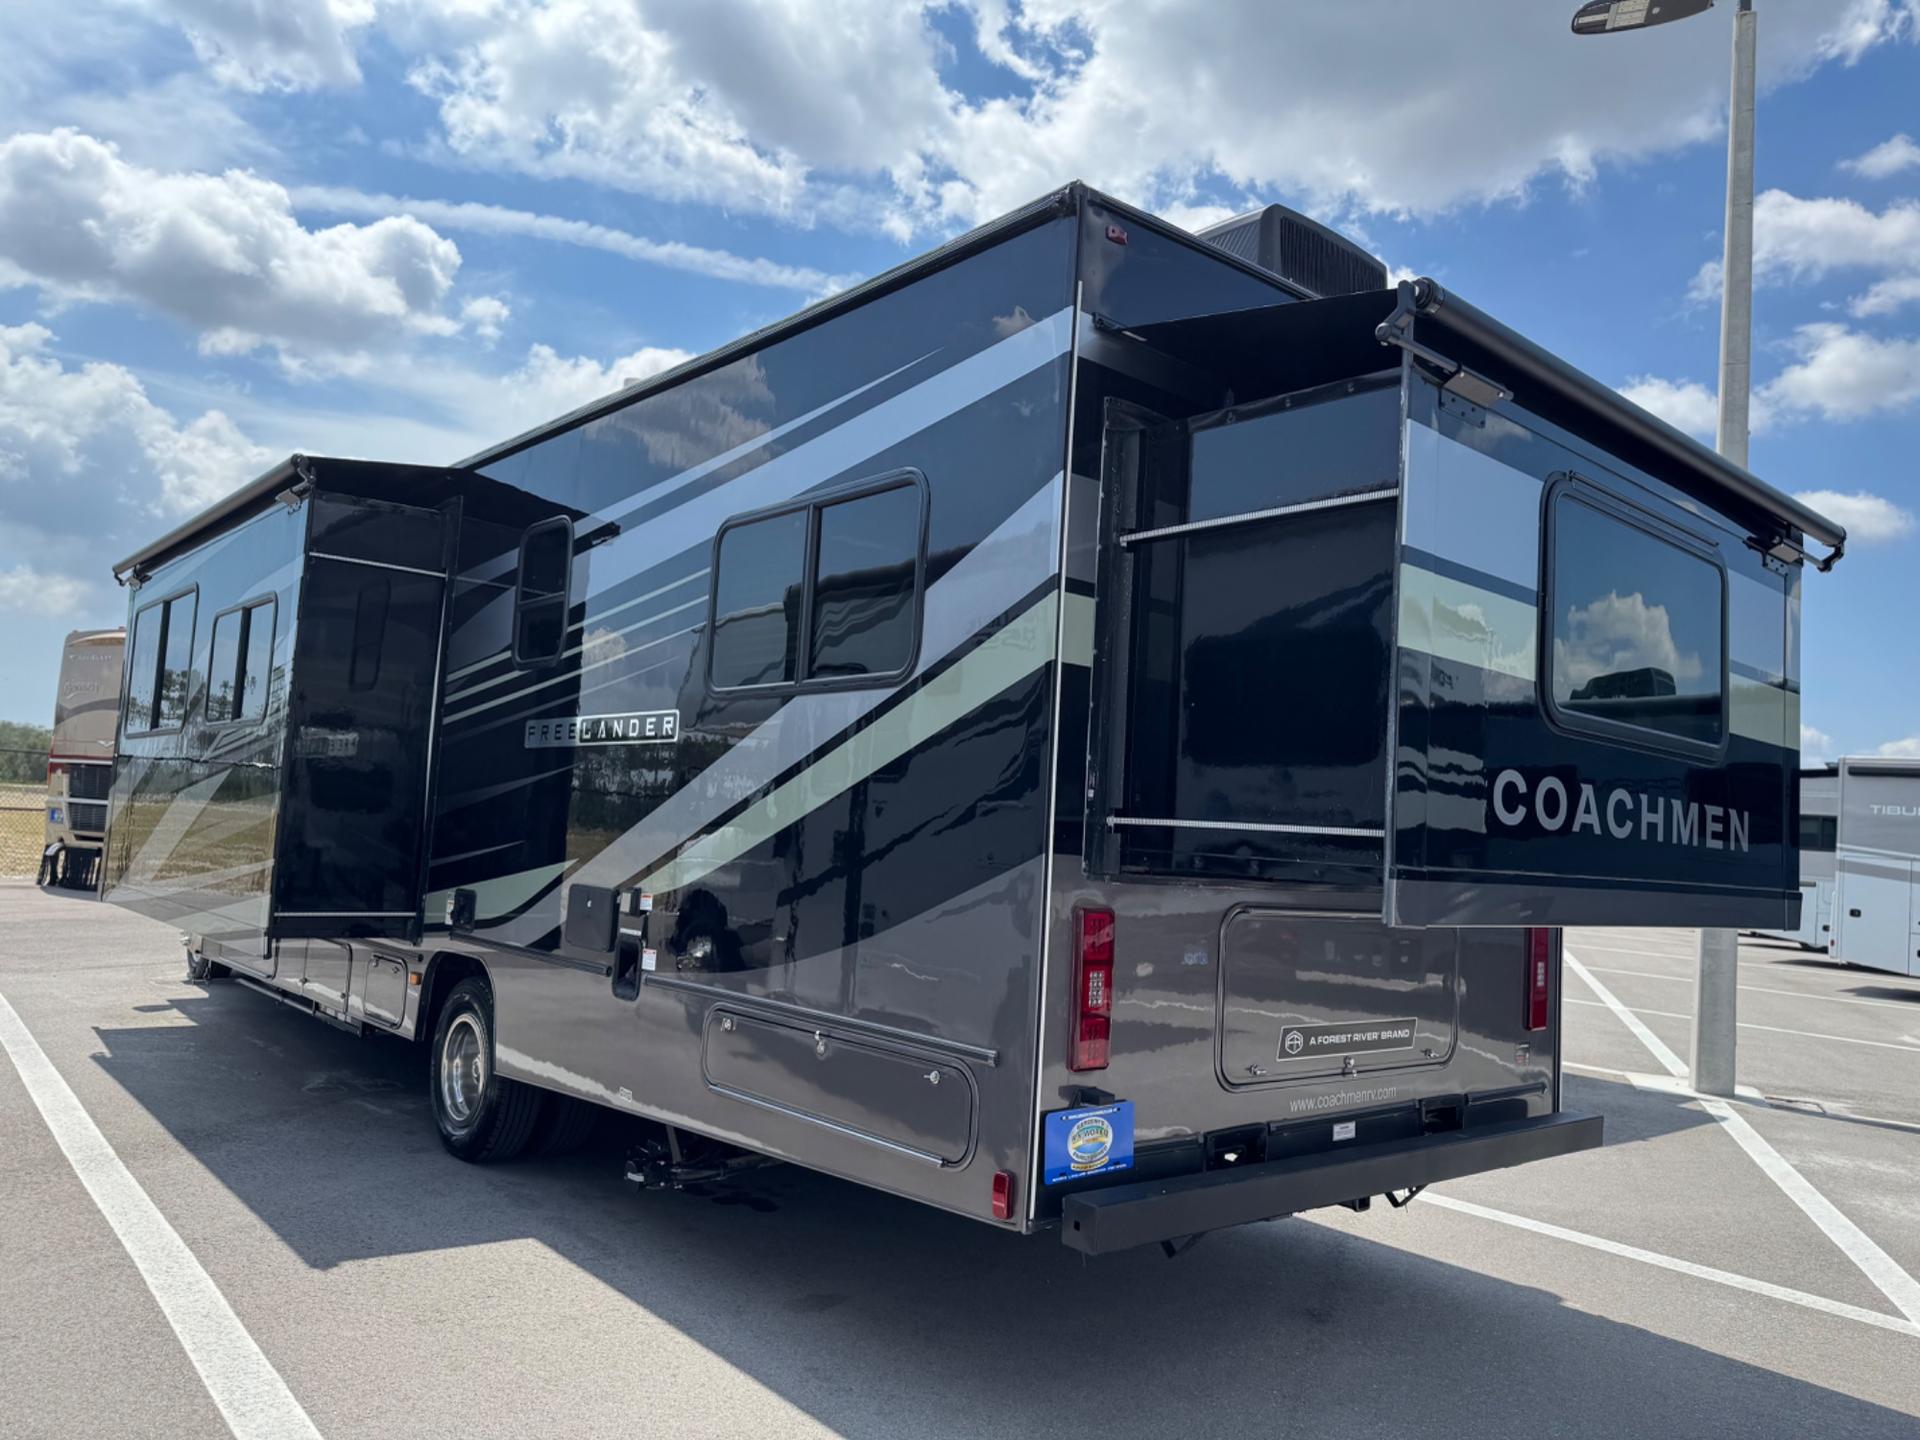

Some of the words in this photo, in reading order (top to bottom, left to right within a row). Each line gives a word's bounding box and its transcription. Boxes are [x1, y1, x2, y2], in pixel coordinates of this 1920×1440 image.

[527, 716, 674, 741] FREELANDER
[1493, 769, 1749, 852] COACHMEN
[1869, 804, 1920, 816] TIBU
[1309, 1036, 1316, 1046] A
[1317, 1034, 1352, 1045] FOREST
[1381, 1029, 1410, 1040] BRAND
